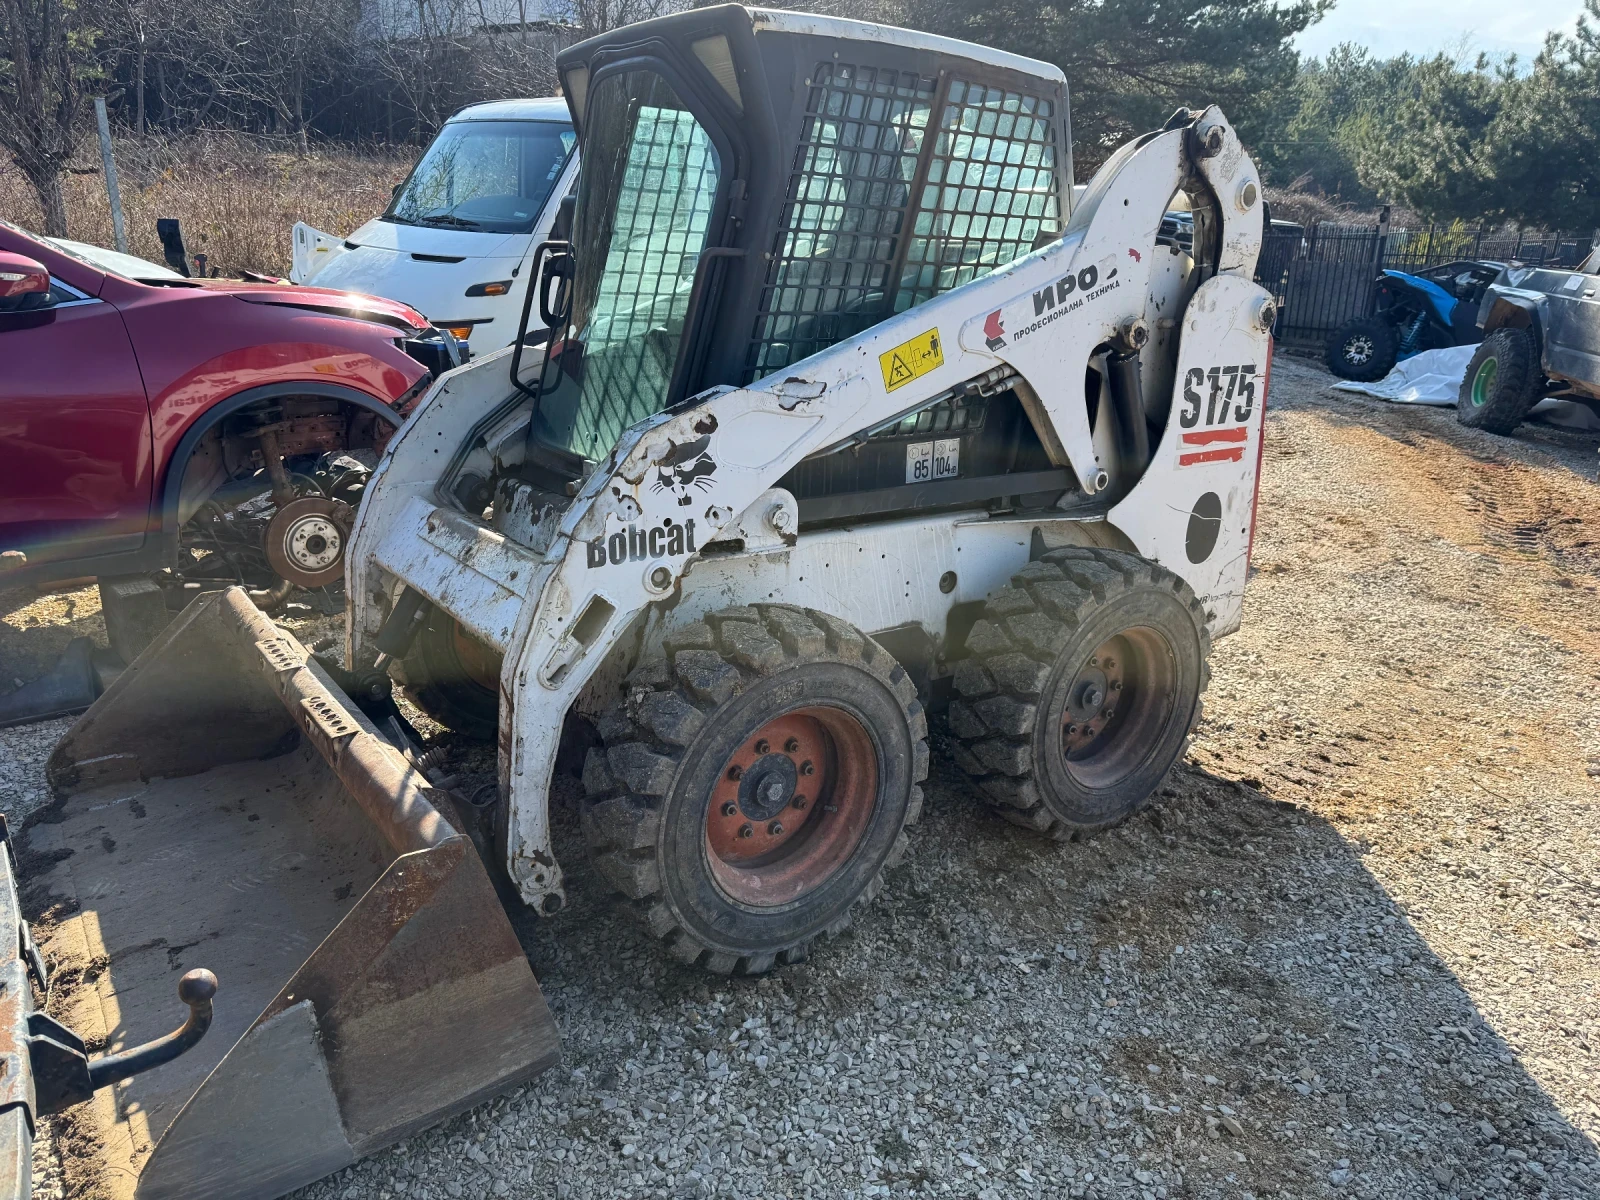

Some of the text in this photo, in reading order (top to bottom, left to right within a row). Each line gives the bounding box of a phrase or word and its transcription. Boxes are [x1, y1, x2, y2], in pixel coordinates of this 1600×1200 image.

[1013, 280, 1120, 341] ПРОФЕСИОНАЛНА ТЕХНИКА
[1032, 264, 1117, 317] ИРО
[1179, 364, 1257, 428] S175
[914, 459, 929, 479] 85
[935, 456, 950, 476] 104
[586, 518, 696, 569] Bobcat
